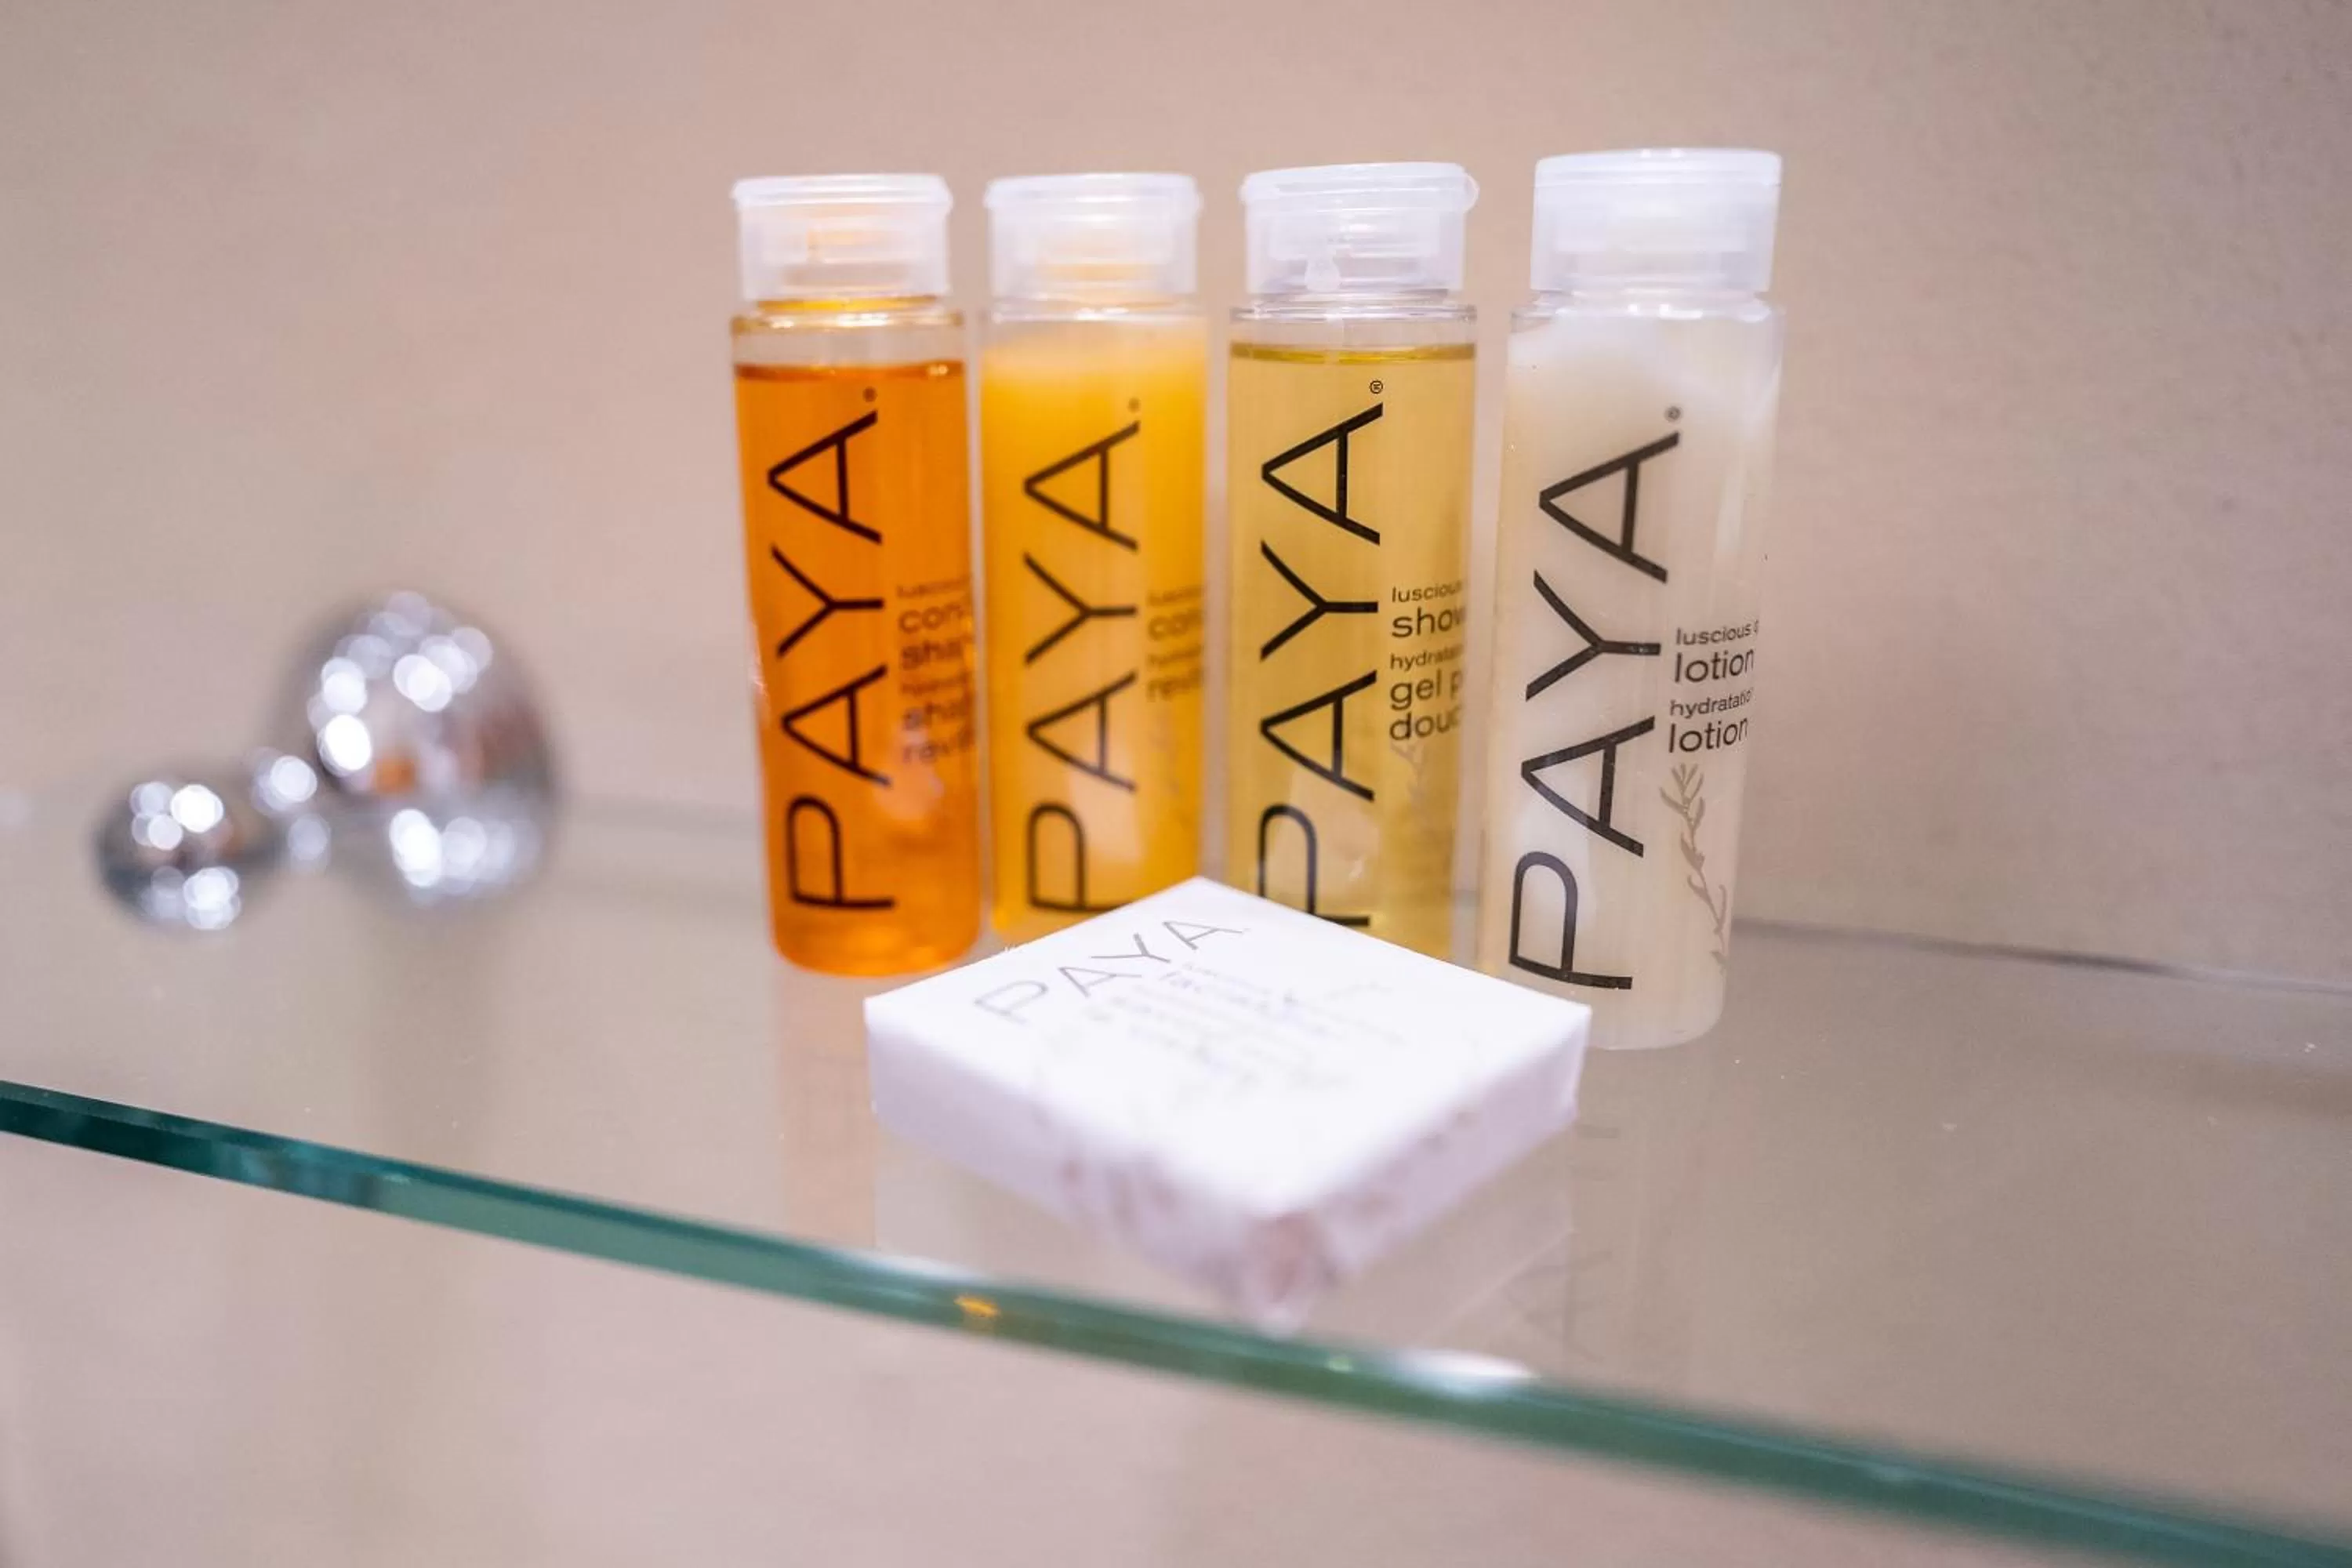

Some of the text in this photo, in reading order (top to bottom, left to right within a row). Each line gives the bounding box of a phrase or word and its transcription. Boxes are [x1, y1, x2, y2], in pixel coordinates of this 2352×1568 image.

[1676, 622, 1752, 645] luscious
[1675, 648, 1755, 683] lotion
[1390, 668, 1443, 711] gel
[1668, 717, 1748, 753] lotion
[974, 920, 1244, 1025] PAYA
